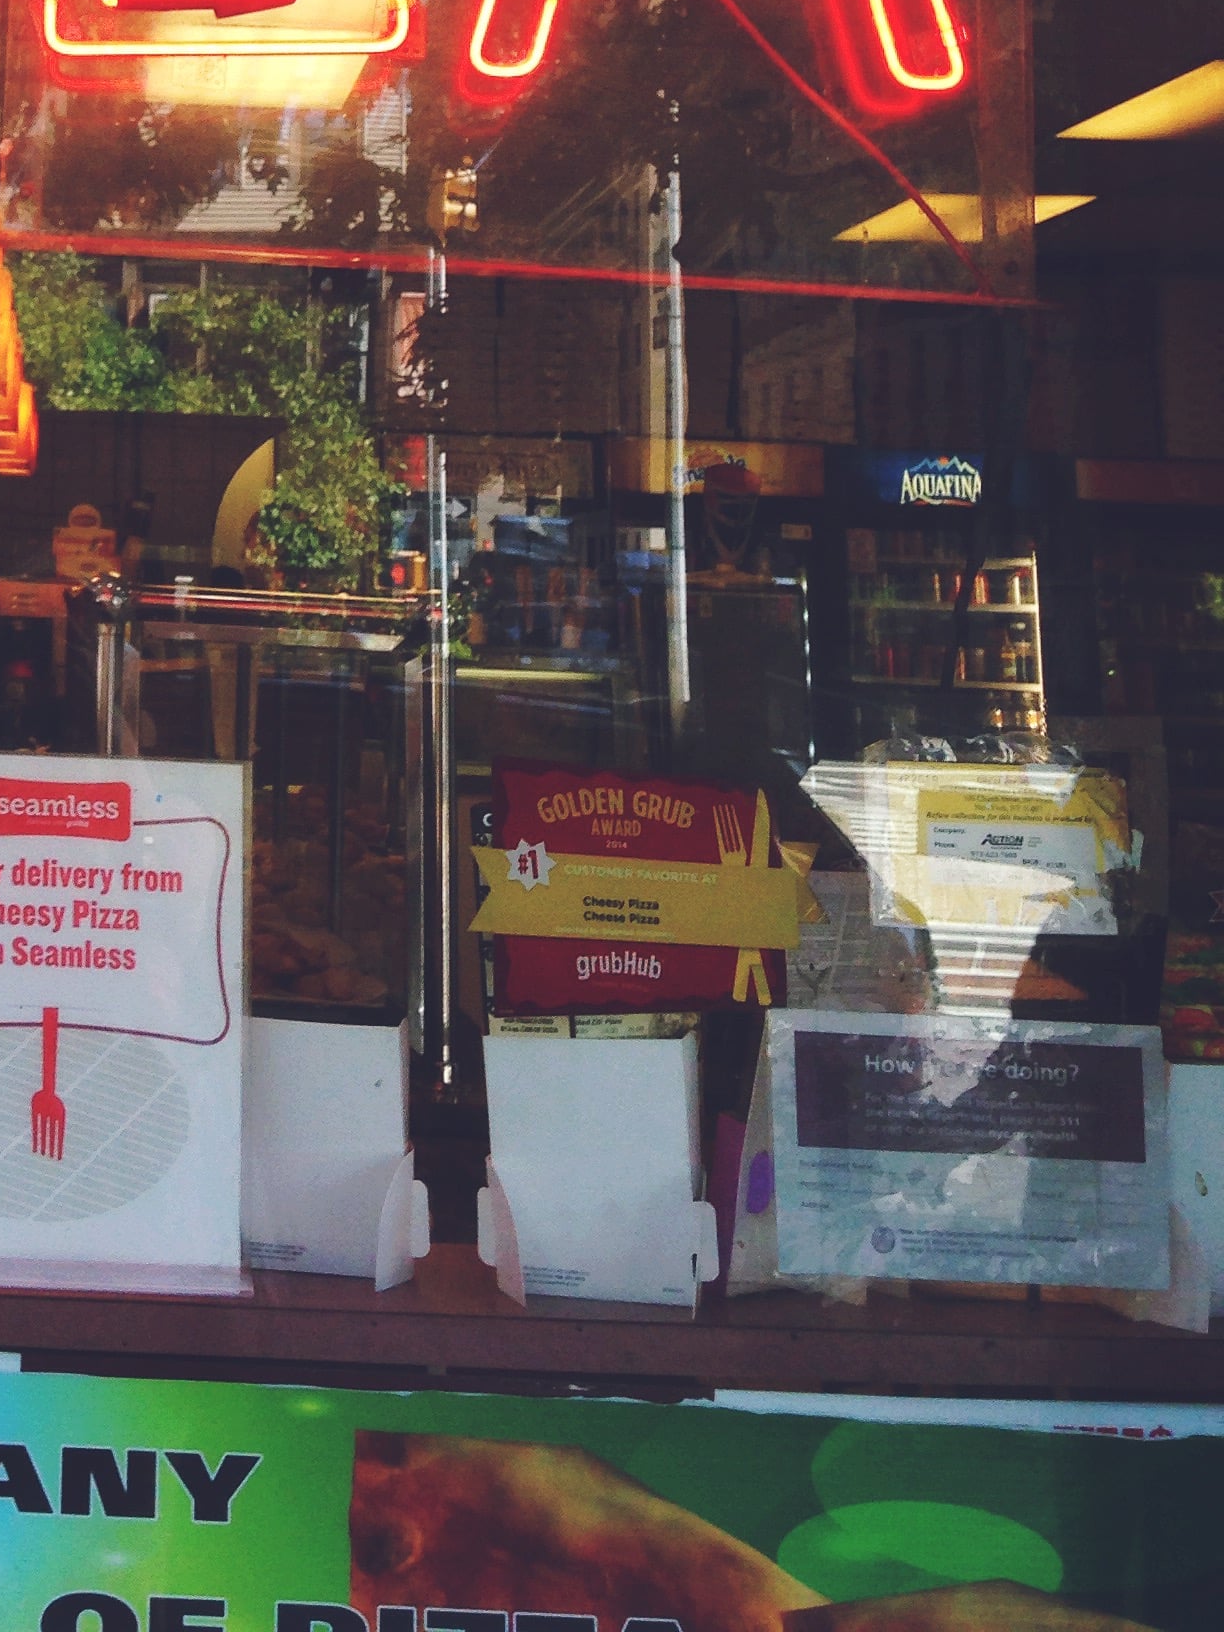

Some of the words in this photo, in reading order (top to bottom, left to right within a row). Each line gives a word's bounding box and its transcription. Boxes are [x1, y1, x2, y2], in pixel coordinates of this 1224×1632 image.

[900, 469, 982, 505] AQUAFINA
[537, 788, 624, 824] GOLDEN
[633, 790, 696, 829] GRUB
[591, 819, 642, 837] AWARD
[606, 839, 628, 850] 2014
[11, 858, 114, 894] delivery
[120, 862, 183, 893] from
[517, 850, 539, 880] #1
[564, 864, 633, 880] CUSTOMER
[637, 868, 699, 884] FAVORITE
[72, 899, 140, 931] Pizza
[583, 895, 625, 910] Cheesy
[628, 898, 660, 910] Pizza
[583, 910, 626, 923] Cheese
[629, 912, 661, 925] Pizza
[11, 937, 136, 970] Seamless
[576, 950, 663, 981] grubHub
[864, 1054, 915, 1075] How
[1005, 1061, 1080, 1087] doing?
